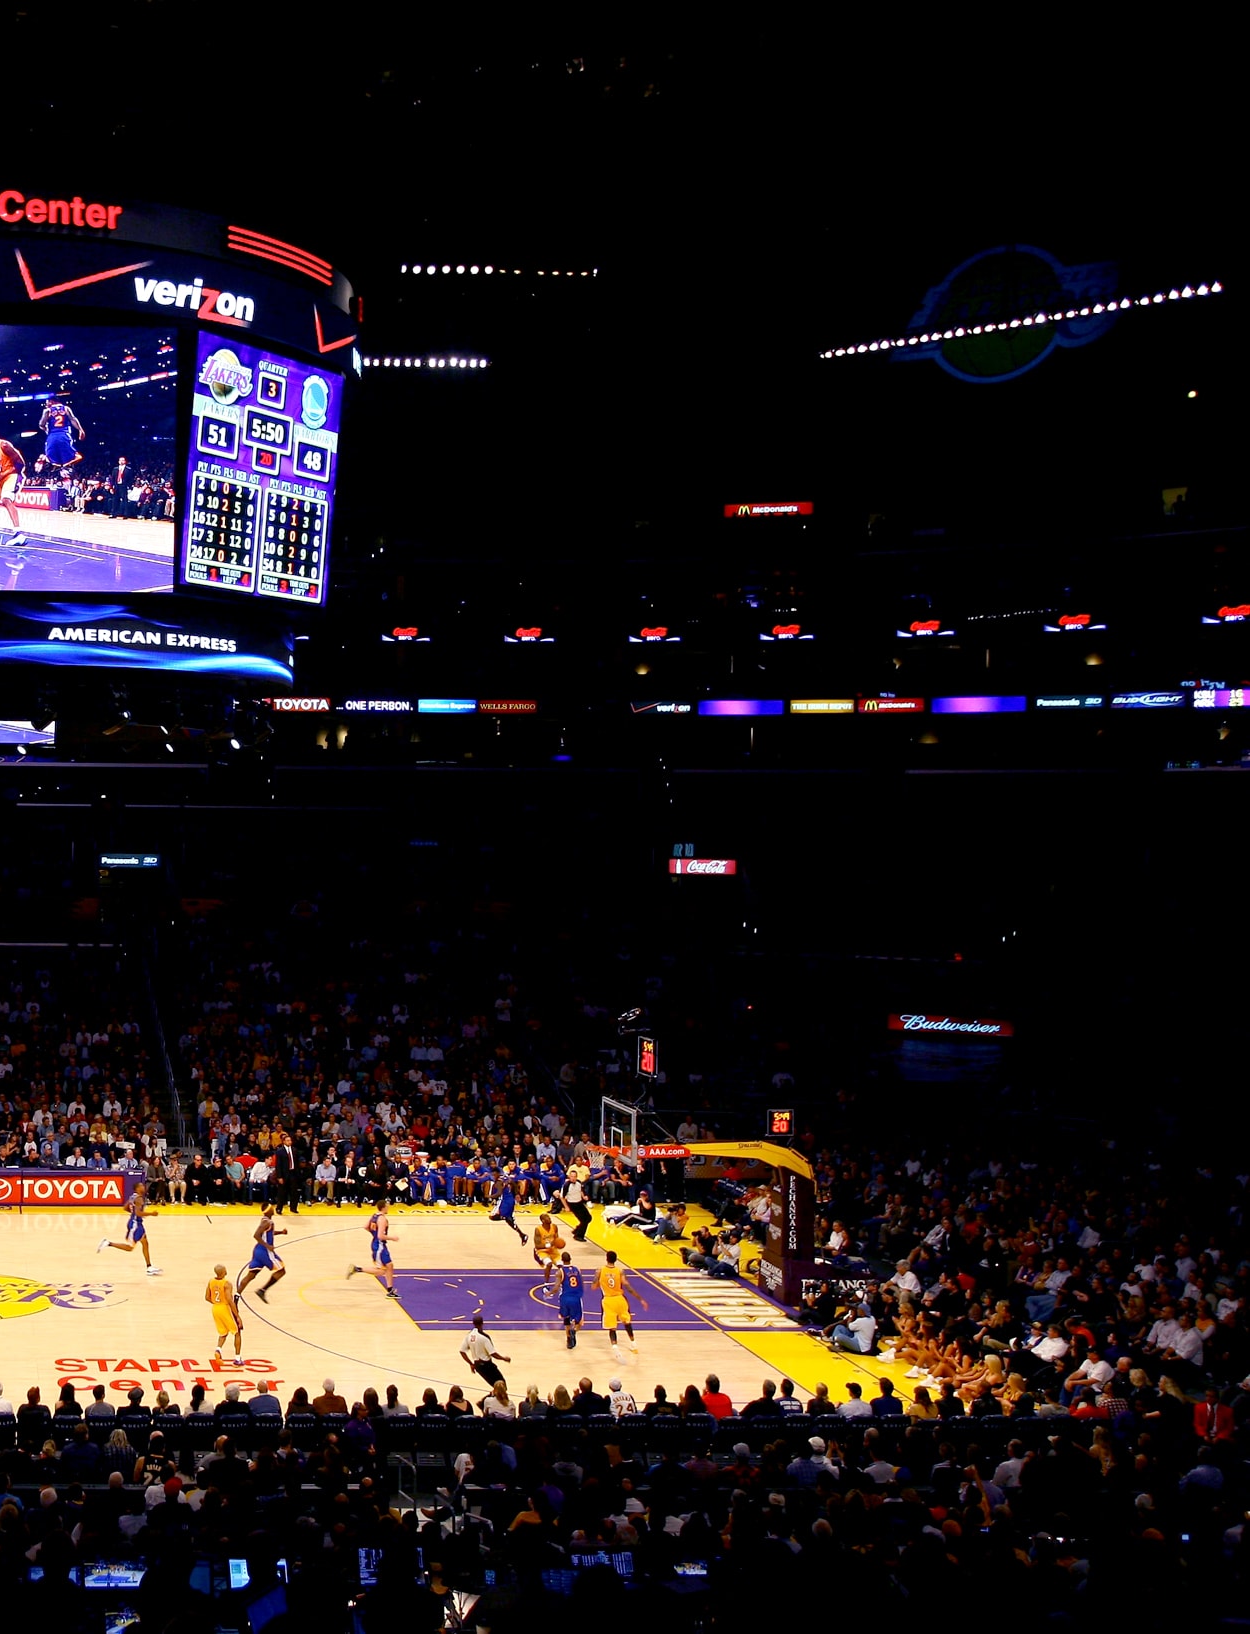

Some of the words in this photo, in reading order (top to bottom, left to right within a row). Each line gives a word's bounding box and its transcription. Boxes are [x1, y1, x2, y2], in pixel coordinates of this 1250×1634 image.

[134, 274, 255, 328] verizon
[259, 360, 288, 376] QUARTER
[202, 360, 249, 394] LAKERS
[268, 382, 277, 397] 3
[203, 401, 239, 420] LAKERS
[55, 416, 64, 427] 2
[208, 424, 227, 447] 51
[252, 418, 284, 444] 5:50
[260, 452, 272, 465] 20
[304, 451, 322, 470] 48
[752, 504, 798, 514] McDonald's
[48, 627, 161, 646] AMERICAN
[167, 633, 237, 652] EXPRESS
[1230, 690, 1244, 698] 16
[274, 699, 330, 710] TOYOTA
[346, 701, 366, 710] ONE
[656, 704, 690, 712] verizon
[1037, 698, 1080, 706] Panasonic
[686, 860, 728, 874] Coca-Cola
[900, 1014, 1000, 1034] Budweiser
[642, 1053, 654, 1072] 20
[774, 1112, 790, 1121] 5:49
[773, 1121, 787, 1132] 20
[650, 1147, 684, 1156] AAA.com
[17, 1180, 122, 1200] TOYOTA
[570, 1276, 578, 1288] 8
[608, 1278, 615, 1289] 9
[214, 1290, 222, 1302] 2
[55, 1358, 278, 1372] STAPLES
[57, 1376, 285, 1392] Center
[616, 1403, 634, 1418] 24
